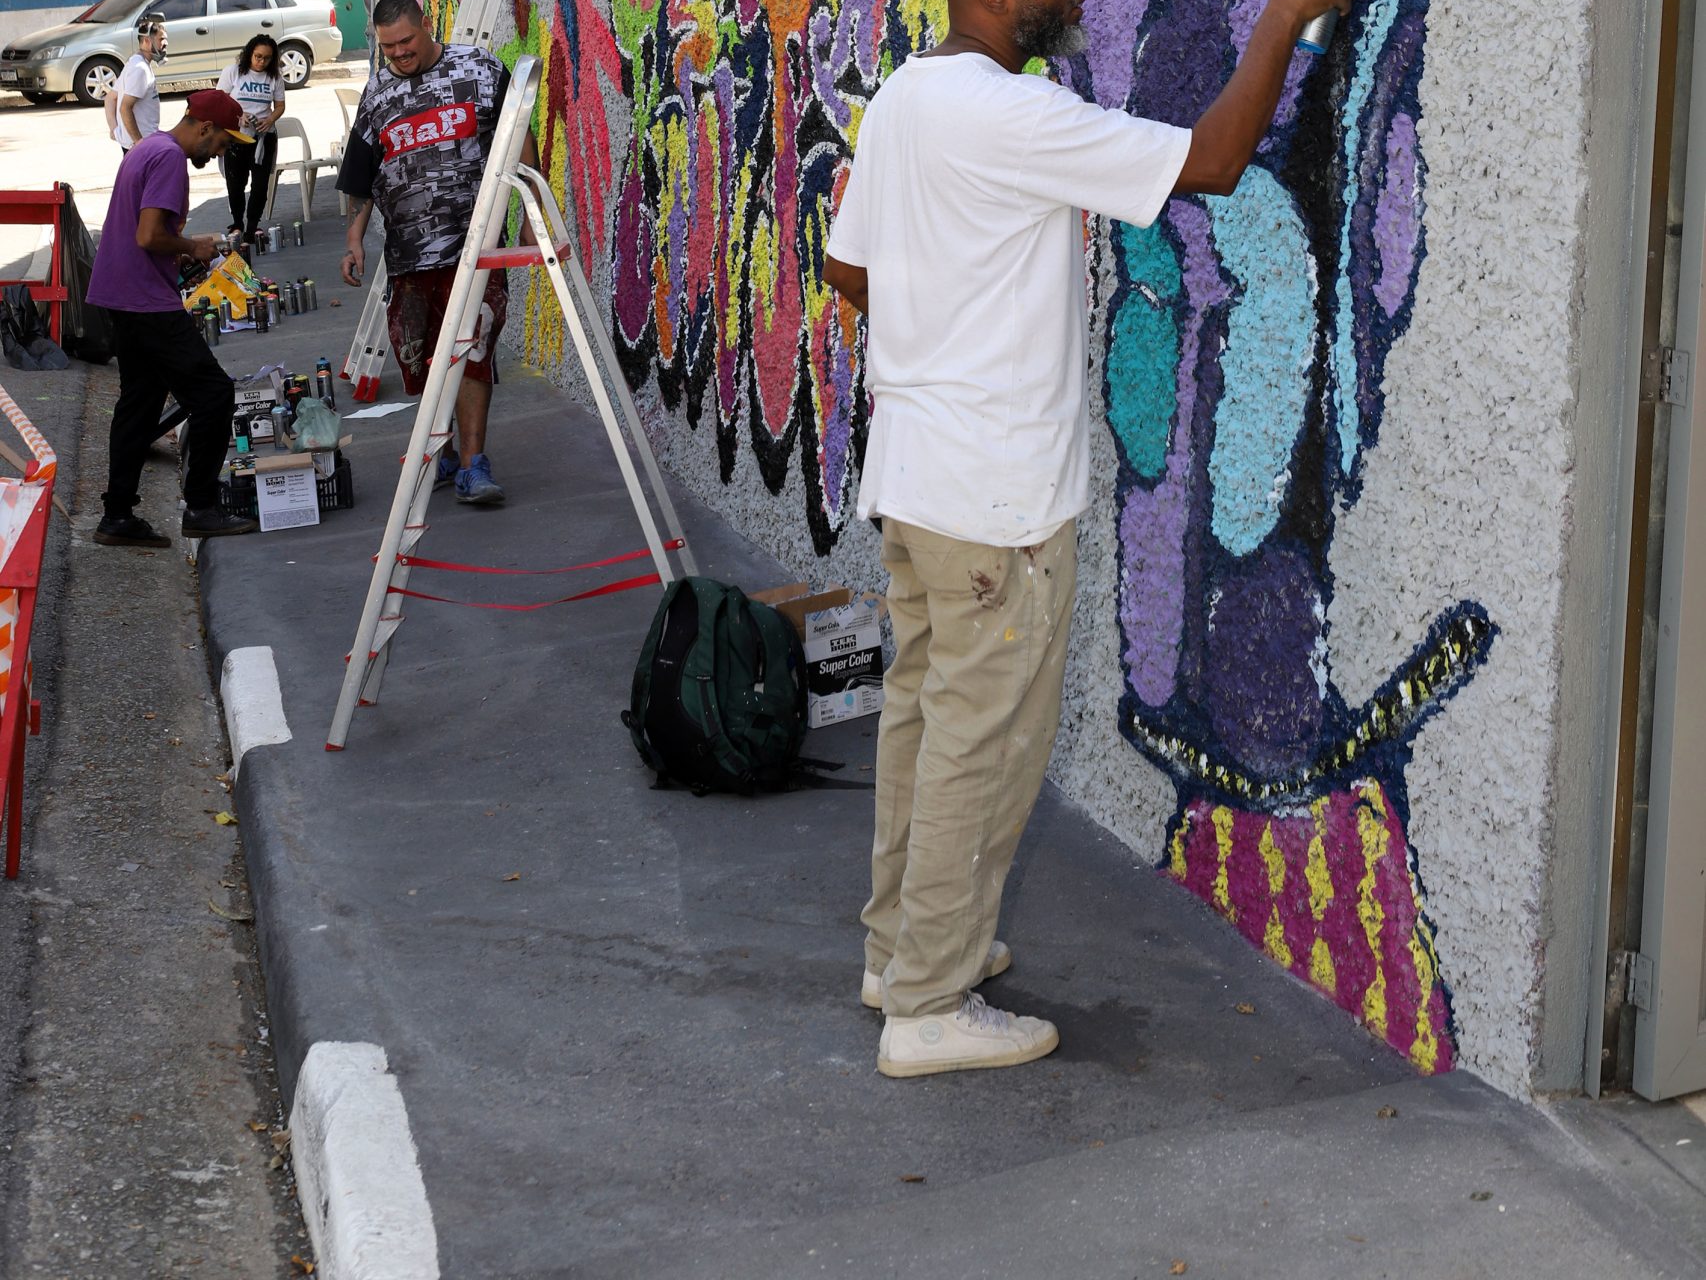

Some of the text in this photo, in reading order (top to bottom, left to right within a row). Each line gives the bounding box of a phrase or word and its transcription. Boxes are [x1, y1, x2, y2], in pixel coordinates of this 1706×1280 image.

[240, 81, 272, 95] ARTE
[387, 107, 467, 153] RaP
[237, 401, 272, 412] Super Color
[830, 641, 857, 652] BOND
[819, 652, 874, 676] Super Color
